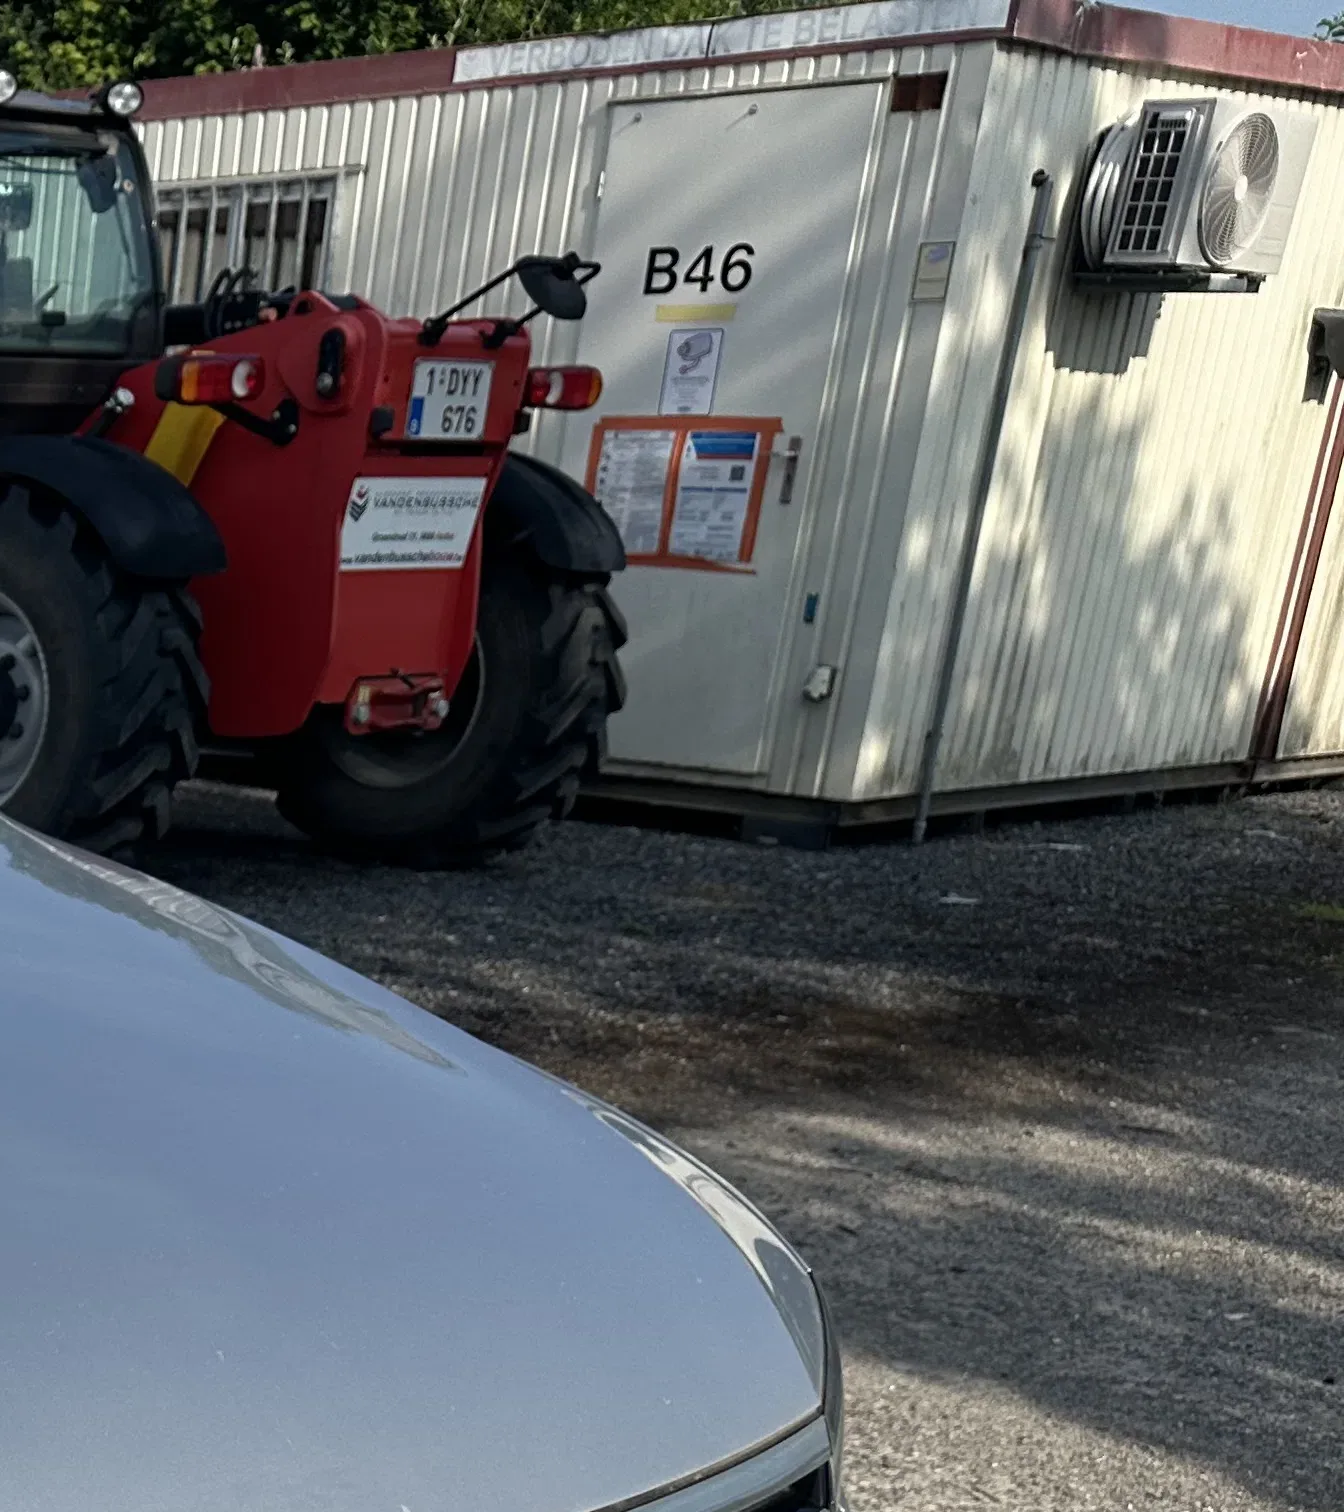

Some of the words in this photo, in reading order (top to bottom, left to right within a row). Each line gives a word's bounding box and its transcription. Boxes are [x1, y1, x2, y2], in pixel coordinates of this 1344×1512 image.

[489, 29, 653, 76] VERBODEN
[663, 22, 733, 58] DAK
[743, 15, 783, 51] TE
[642, 242, 756, 295] B46
[441, 405, 477, 433] 676
